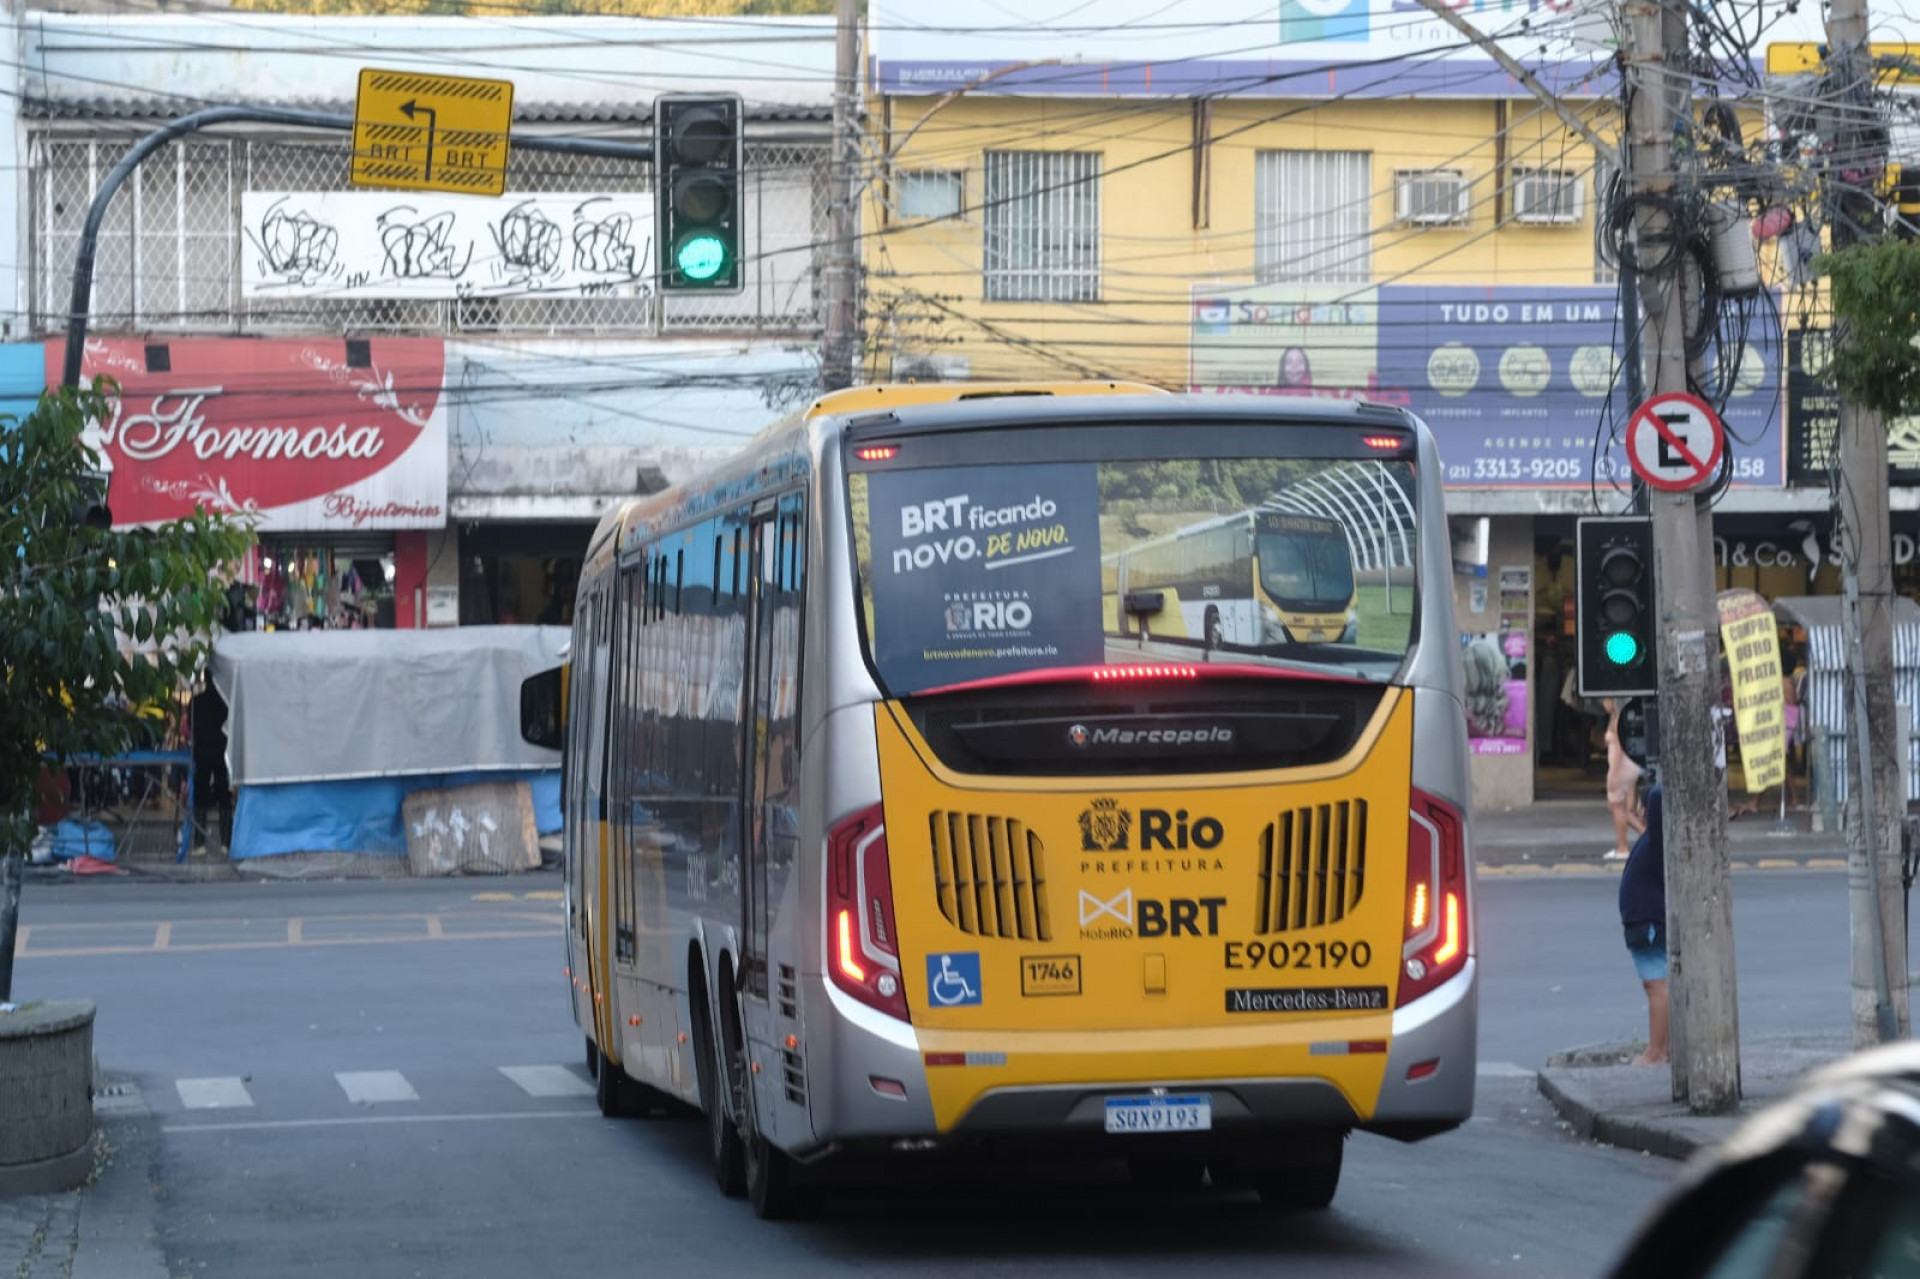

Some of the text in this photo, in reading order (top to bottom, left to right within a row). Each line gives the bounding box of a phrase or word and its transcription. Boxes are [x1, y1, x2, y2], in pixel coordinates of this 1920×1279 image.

[370, 143, 409, 162] BRT
[446, 150, 488, 169] BRT
[1440, 305, 1509, 322] TUDO
[1521, 305, 1553, 322] EM
[1566, 304, 1600, 322] UM
[119, 386, 384, 460] Formosa
[1484, 437, 1550, 448] AGENDE
[1658, 414, 1690, 468] E
[1450, 457, 1581, 479] (21) 3313-9205
[901, 494, 1057, 537] BRT ficando
[893, 524, 1069, 574] novo. DE NOVO.
[1732, 542, 1749, 566] &
[1754, 542, 1798, 567] Co.
[944, 590, 1030, 602] PREFEITURA
[973, 601, 1032, 631] RIO
[1736, 638, 1771, 661] OURO
[1738, 660, 1776, 685] PRATA
[1092, 727, 1232, 744] Marcopolo
[1140, 809, 1224, 850] Rio
[1081, 858, 1224, 873] PREFEITURA
[1138, 897, 1226, 938] BRT
[1080, 927, 1133, 940] MobiRIO
[1225, 941, 1372, 968] E902190
[1029, 962, 1074, 981] 1746
[1233, 988, 1382, 1010] Mercedes-Benz
[1115, 1109, 1199, 1129] SQX9193
